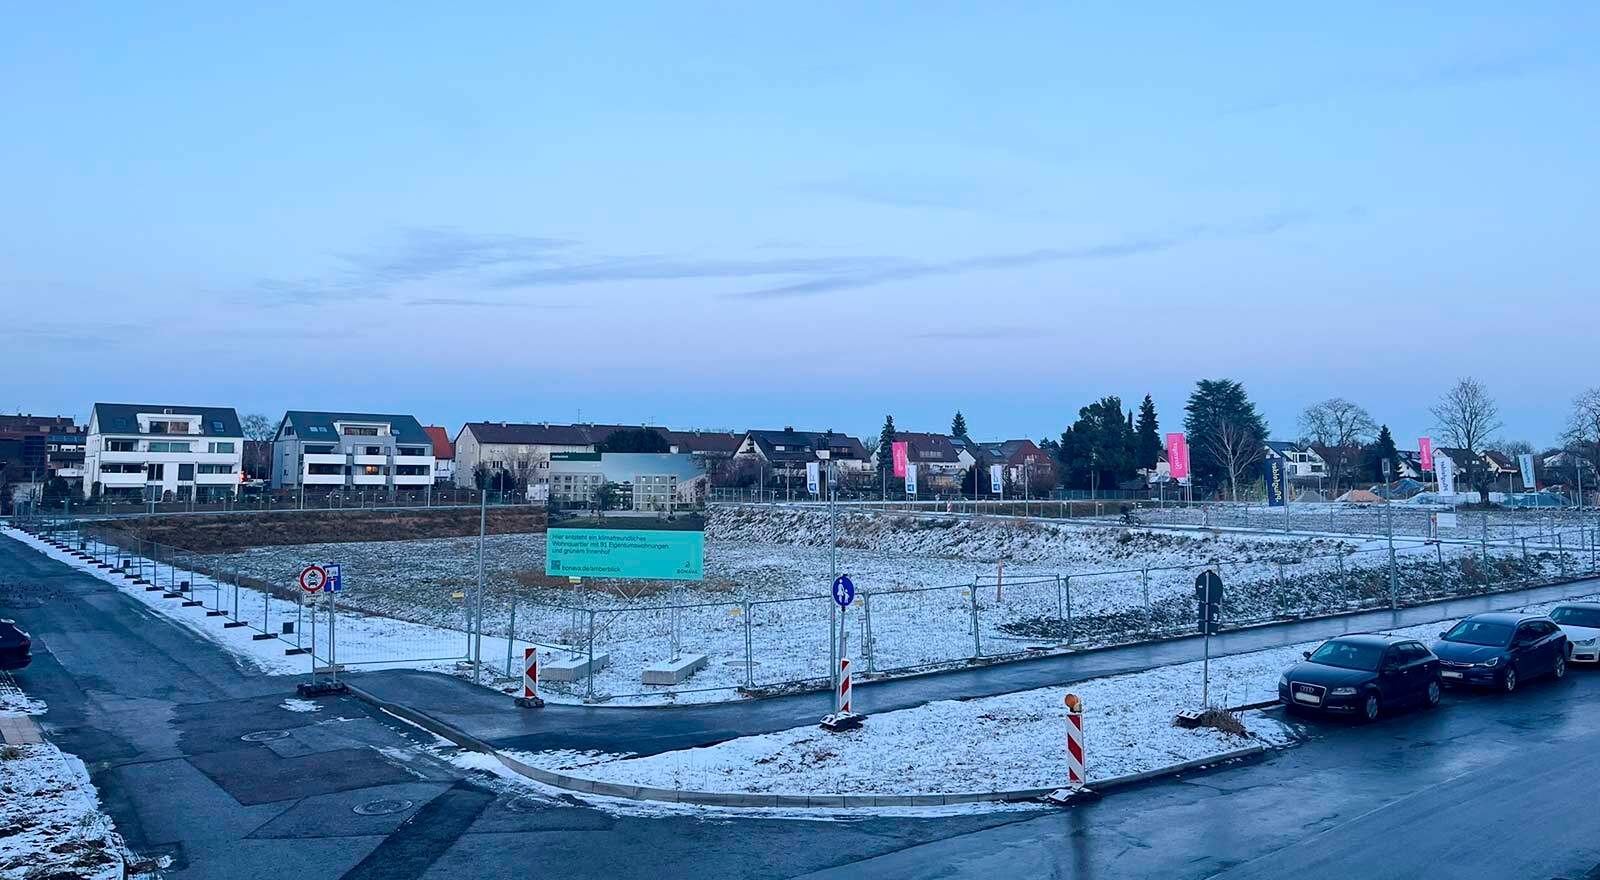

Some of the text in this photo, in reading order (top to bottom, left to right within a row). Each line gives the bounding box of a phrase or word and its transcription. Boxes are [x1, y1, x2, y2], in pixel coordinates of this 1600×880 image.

[598, 534, 646, 542] klimafreundliches
[552, 540, 590, 548] Wohnquartier
[609, 541, 669, 549] Eigentumswohnungen
